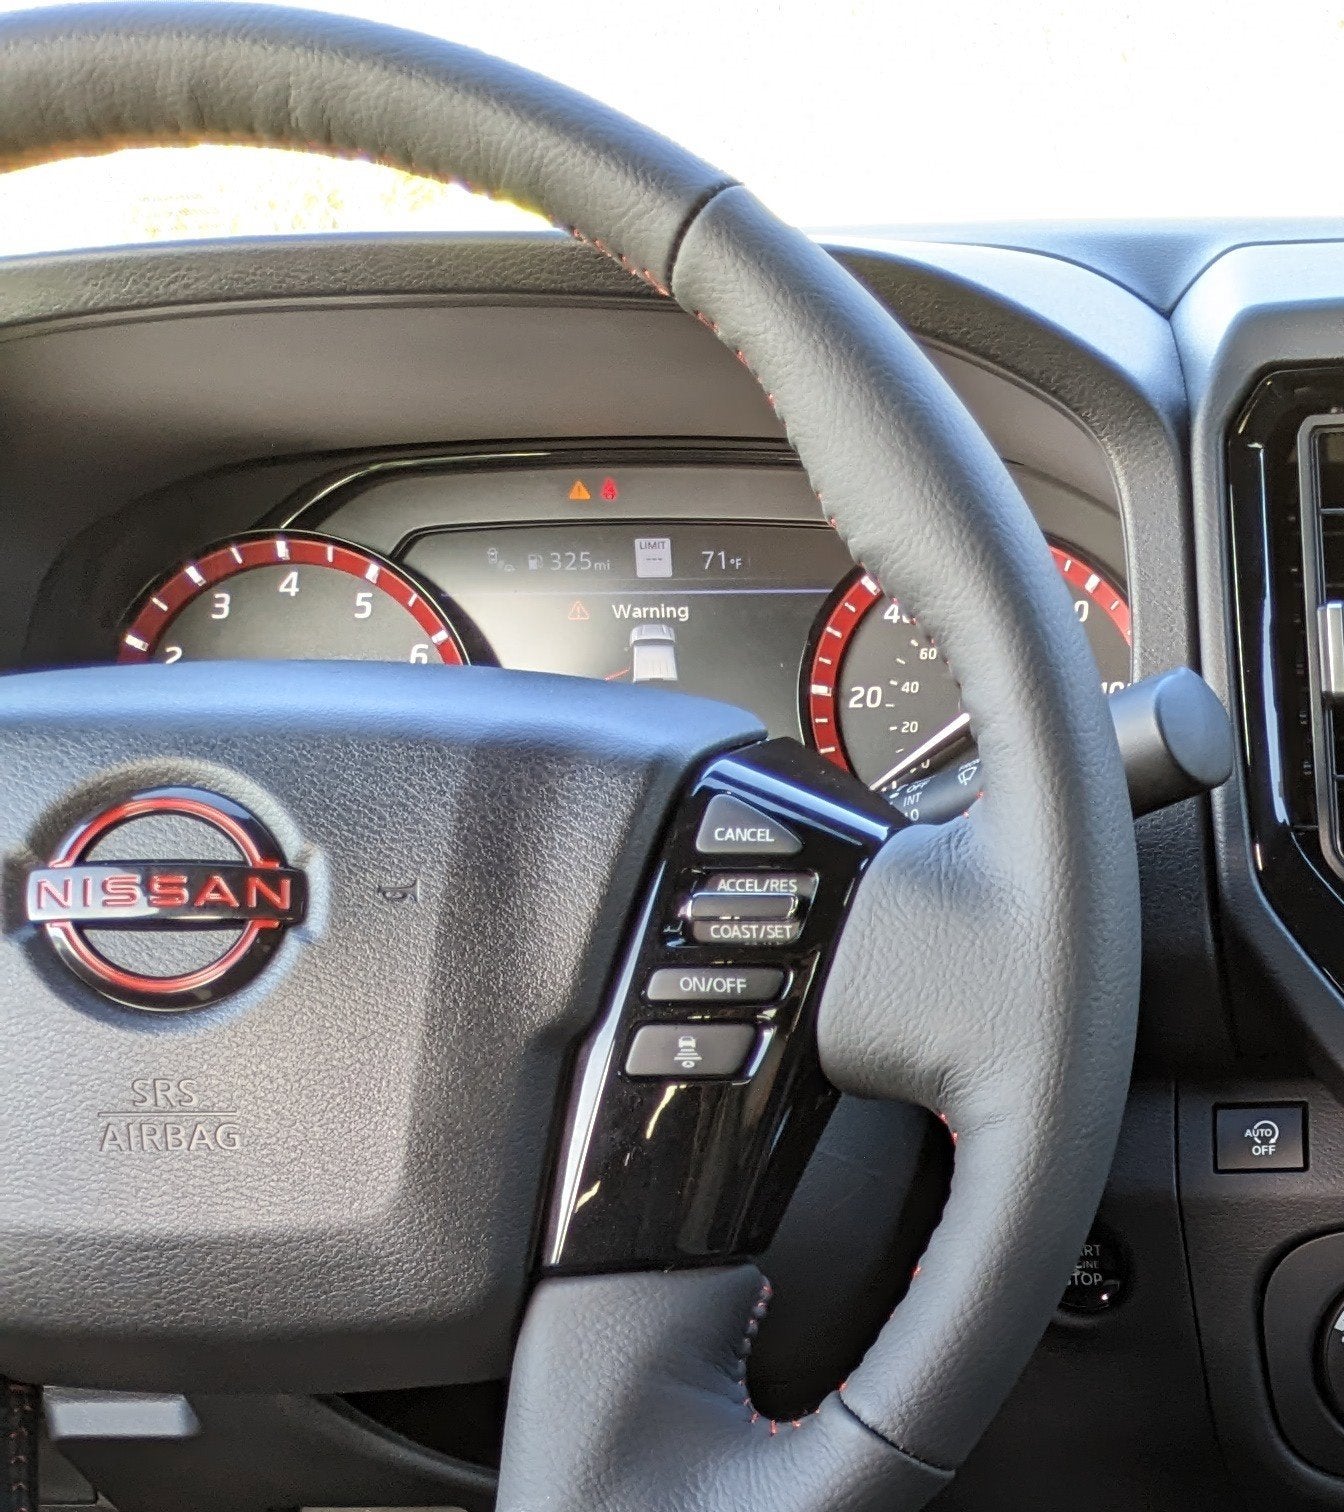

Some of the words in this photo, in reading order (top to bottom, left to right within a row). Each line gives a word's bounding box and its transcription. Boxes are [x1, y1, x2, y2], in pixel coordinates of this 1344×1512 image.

[279, 571, 299, 597] 4
[211, 593, 231, 619] 3
[354, 592, 372, 618] 5
[612, 604, 689, 622] Warning
[920, 648, 937, 660] 60
[902, 681, 920, 693] 40
[849, 686, 882, 708] 20
[902, 721, 918, 733] 20
[714, 828, 774, 842] CANCEL
[36, 873, 293, 910] NISSAN
[716, 878, 798, 892] ACCEL/RES
[710, 925, 792, 939] COAST/SET
[680, 977, 746, 993] ON/OFF
[131, 1078, 198, 1107] SRS
[98, 1121, 242, 1152] AIRBAG
[1245, 1128, 1273, 1138] AUTO
[1252, 1145, 1276, 1156] OFF
